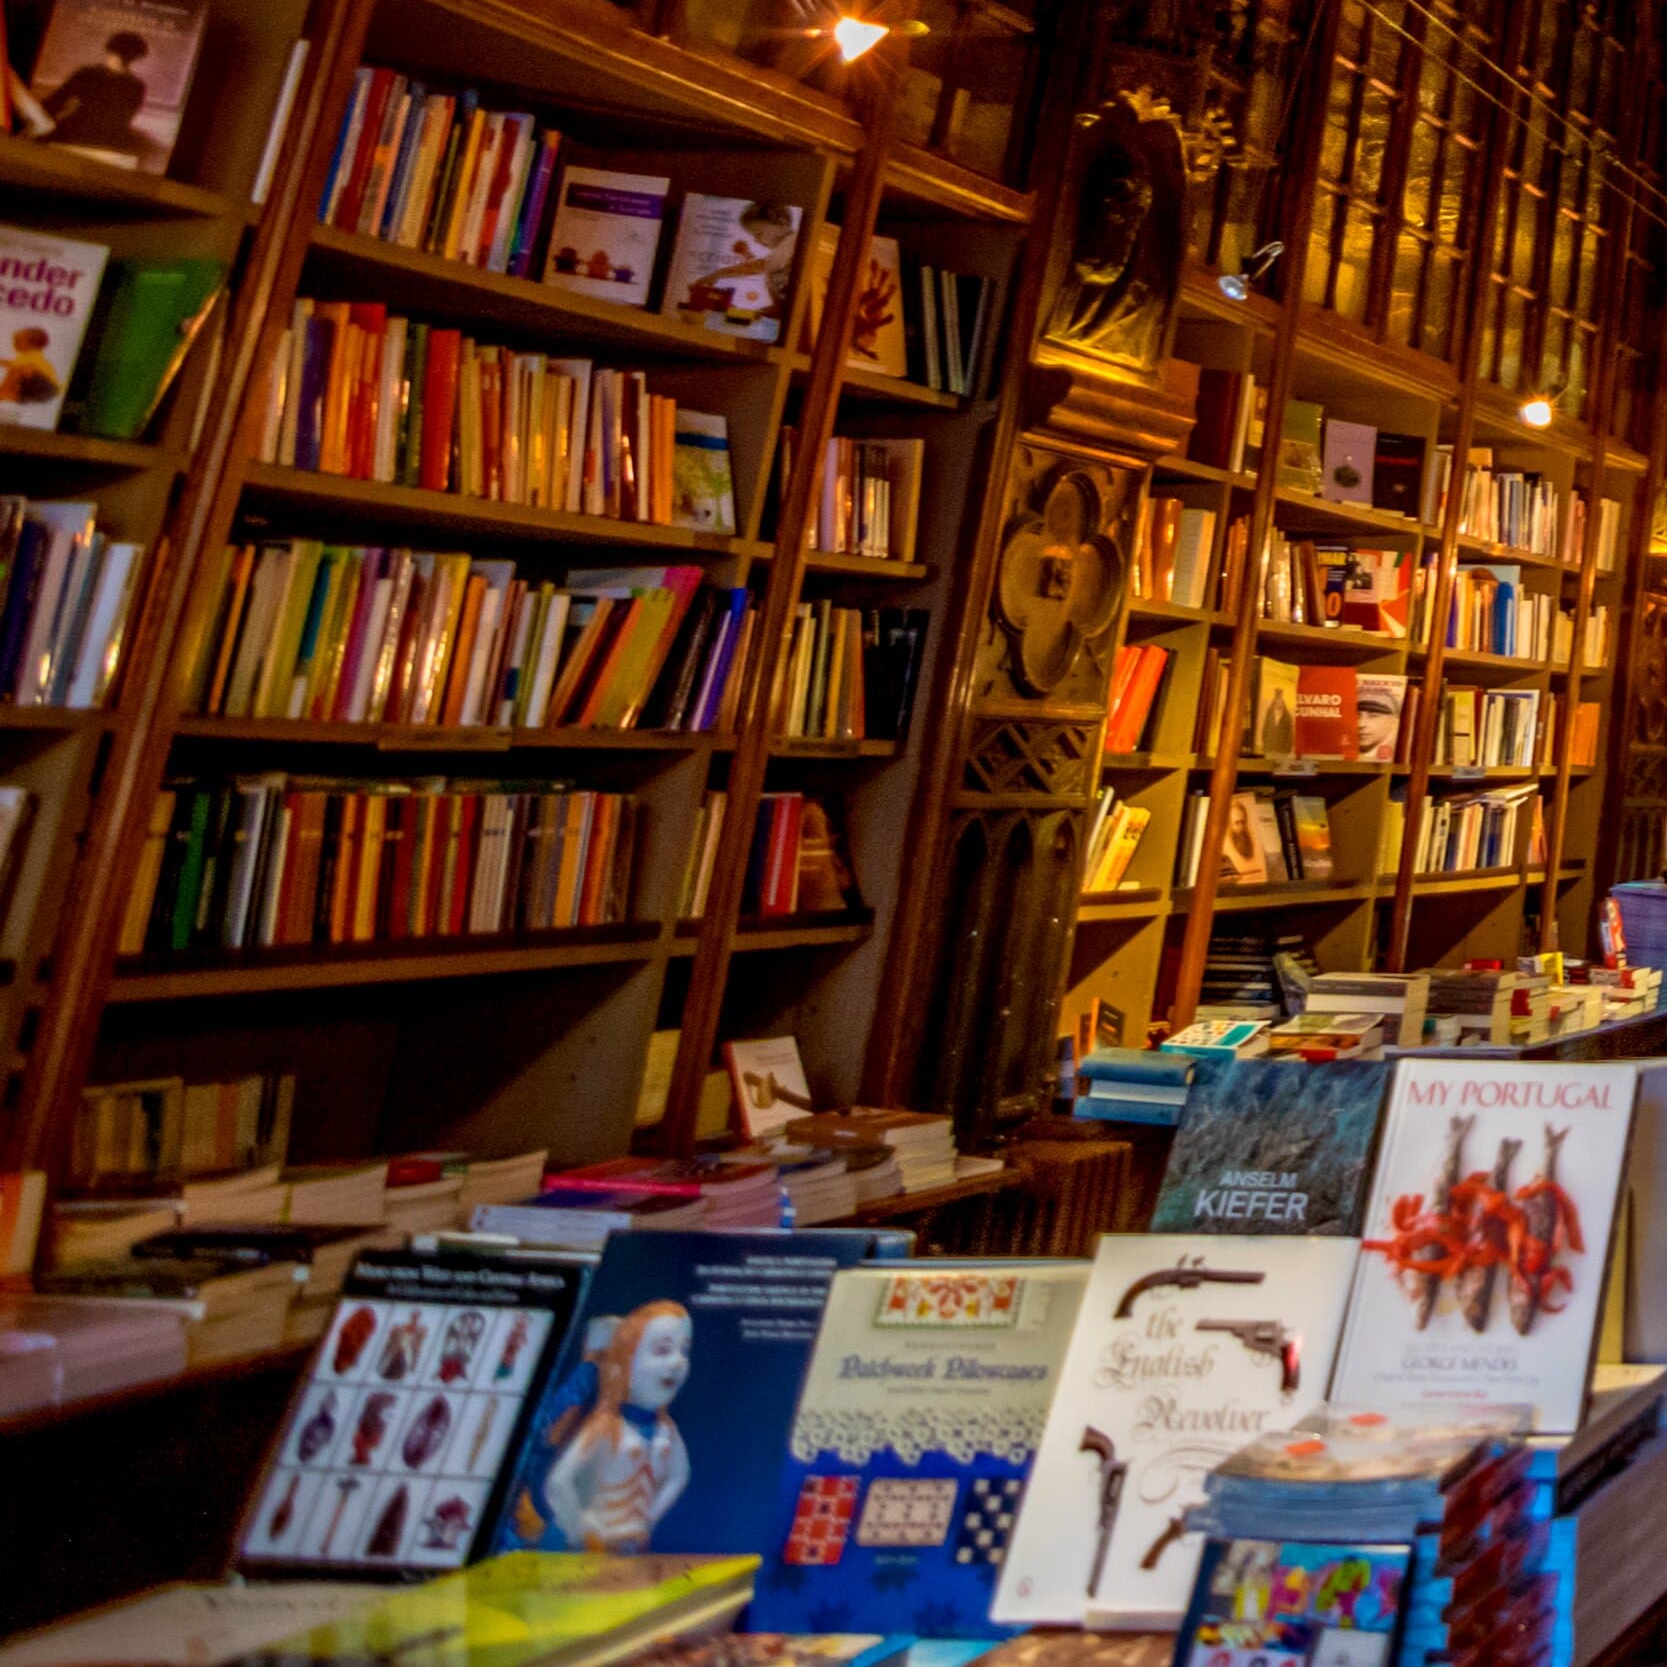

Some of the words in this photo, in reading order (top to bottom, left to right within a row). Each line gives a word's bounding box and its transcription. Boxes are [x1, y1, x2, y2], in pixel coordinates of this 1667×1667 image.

[1408, 1081, 1452, 1106] MY
[1460, 1081, 1615, 1109] PORTUGAL
[1218, 1170, 1299, 1188] ANSELM
[1192, 1189, 1310, 1220] KIEFER
